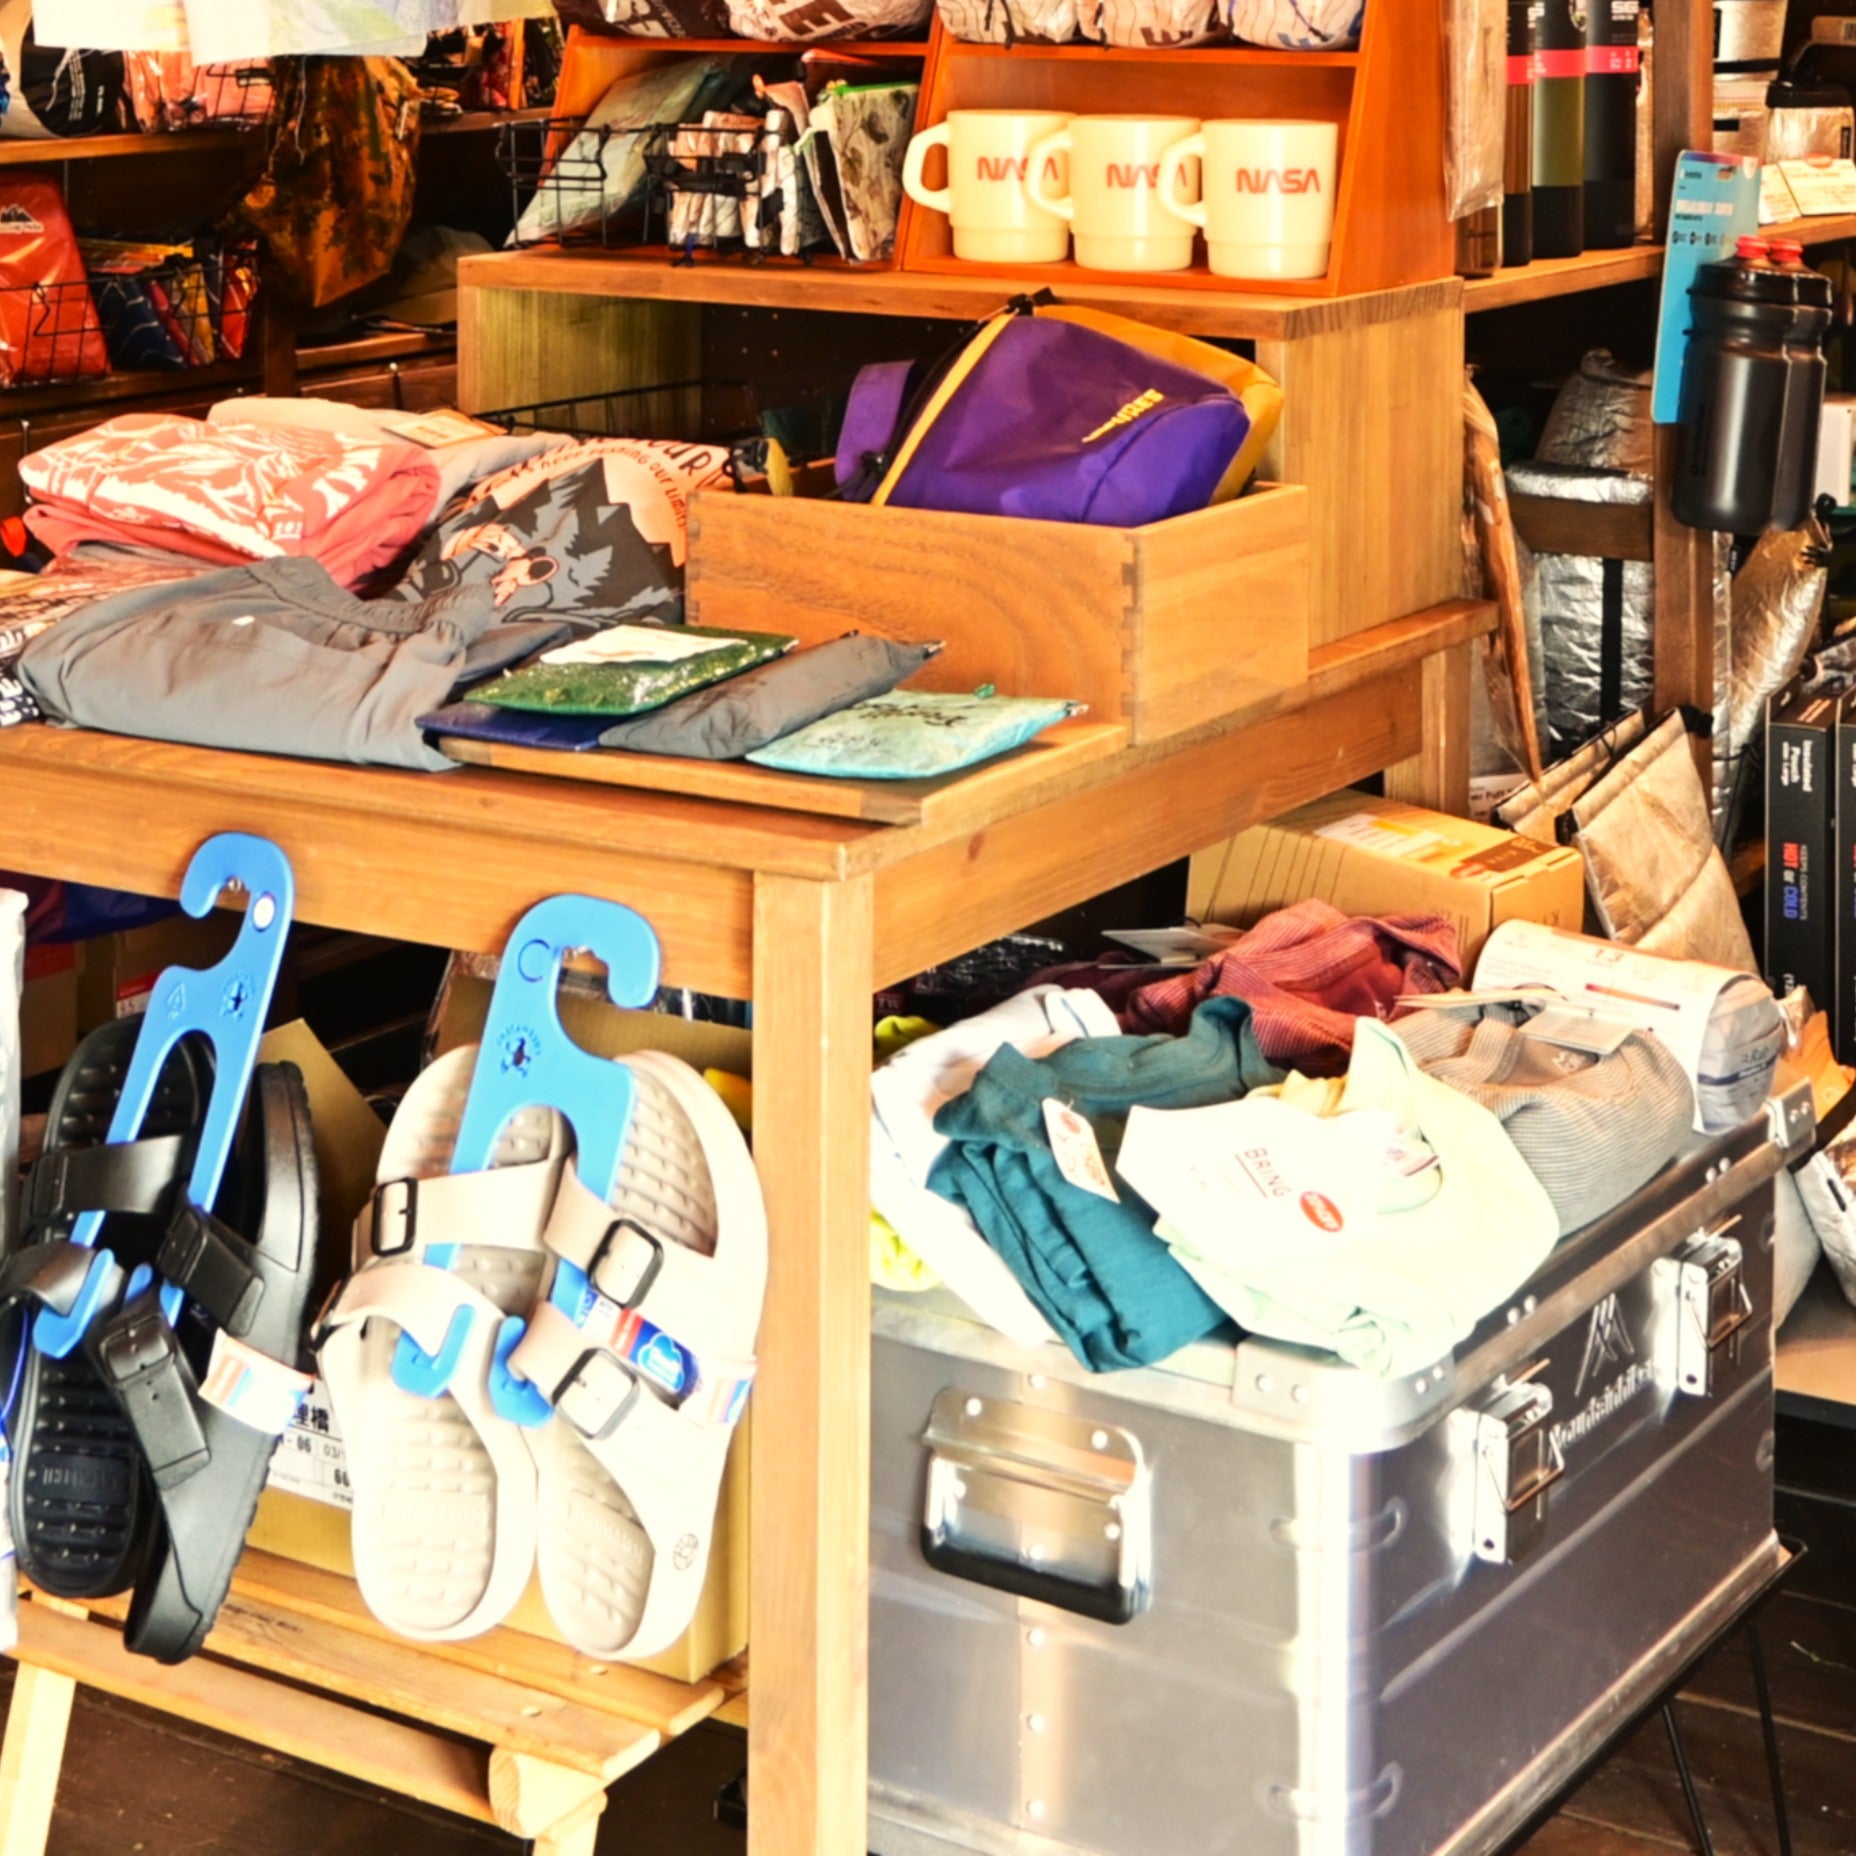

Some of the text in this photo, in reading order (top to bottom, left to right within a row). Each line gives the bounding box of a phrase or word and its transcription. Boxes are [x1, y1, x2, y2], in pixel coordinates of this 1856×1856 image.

[1235, 168, 1321, 195] NASA
[1789, 745, 1801, 784] Pouch
[1801, 739, 1813, 793] Insulated
[1782, 842, 1799, 919] HOT or COLD
[1799, 873, 1808, 921] CONTENTS
